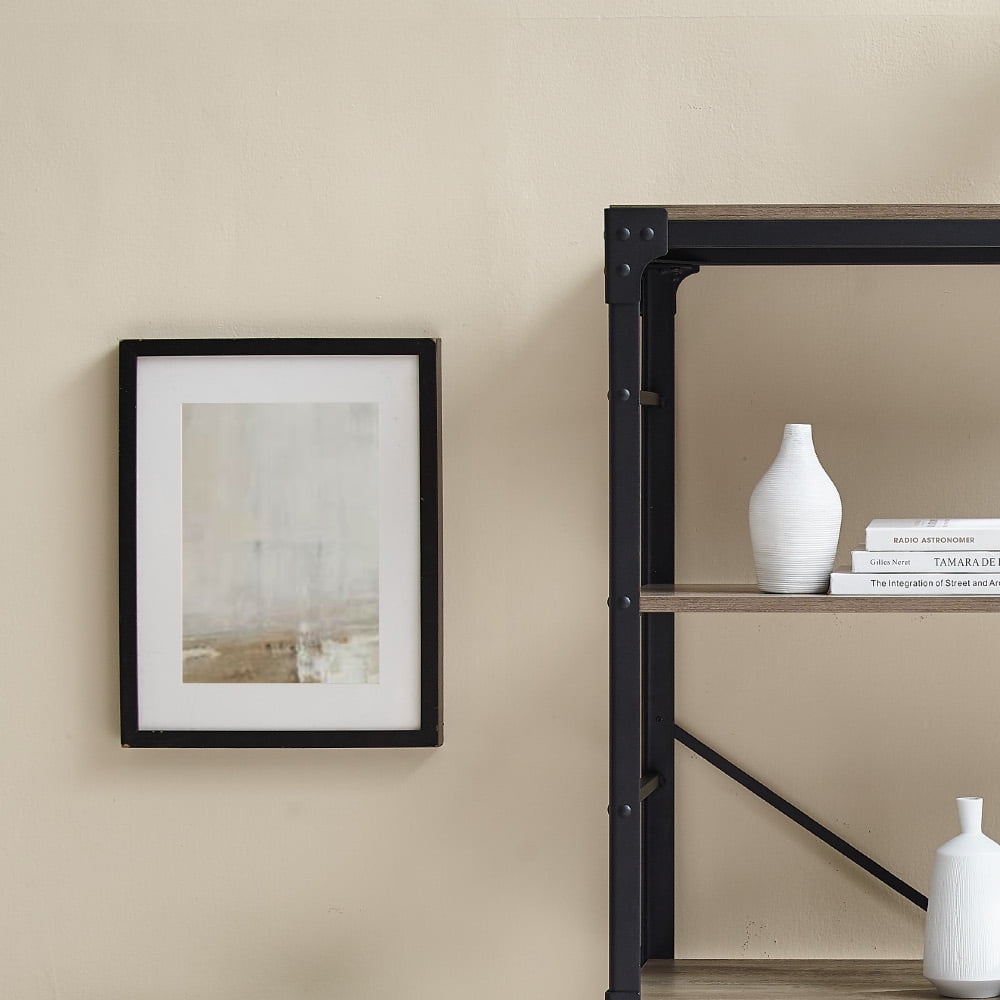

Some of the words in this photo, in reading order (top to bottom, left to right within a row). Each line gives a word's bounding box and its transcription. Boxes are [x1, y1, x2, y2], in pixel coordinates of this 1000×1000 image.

[934, 557, 980, 567] TAMARA
[981, 557, 996, 567] DE
[870, 579, 887, 587] The
[888, 579, 934, 588] Integration
[935, 579, 943, 587] of
[945, 579, 971, 587] Street
[972, 579, 988, 587] and
